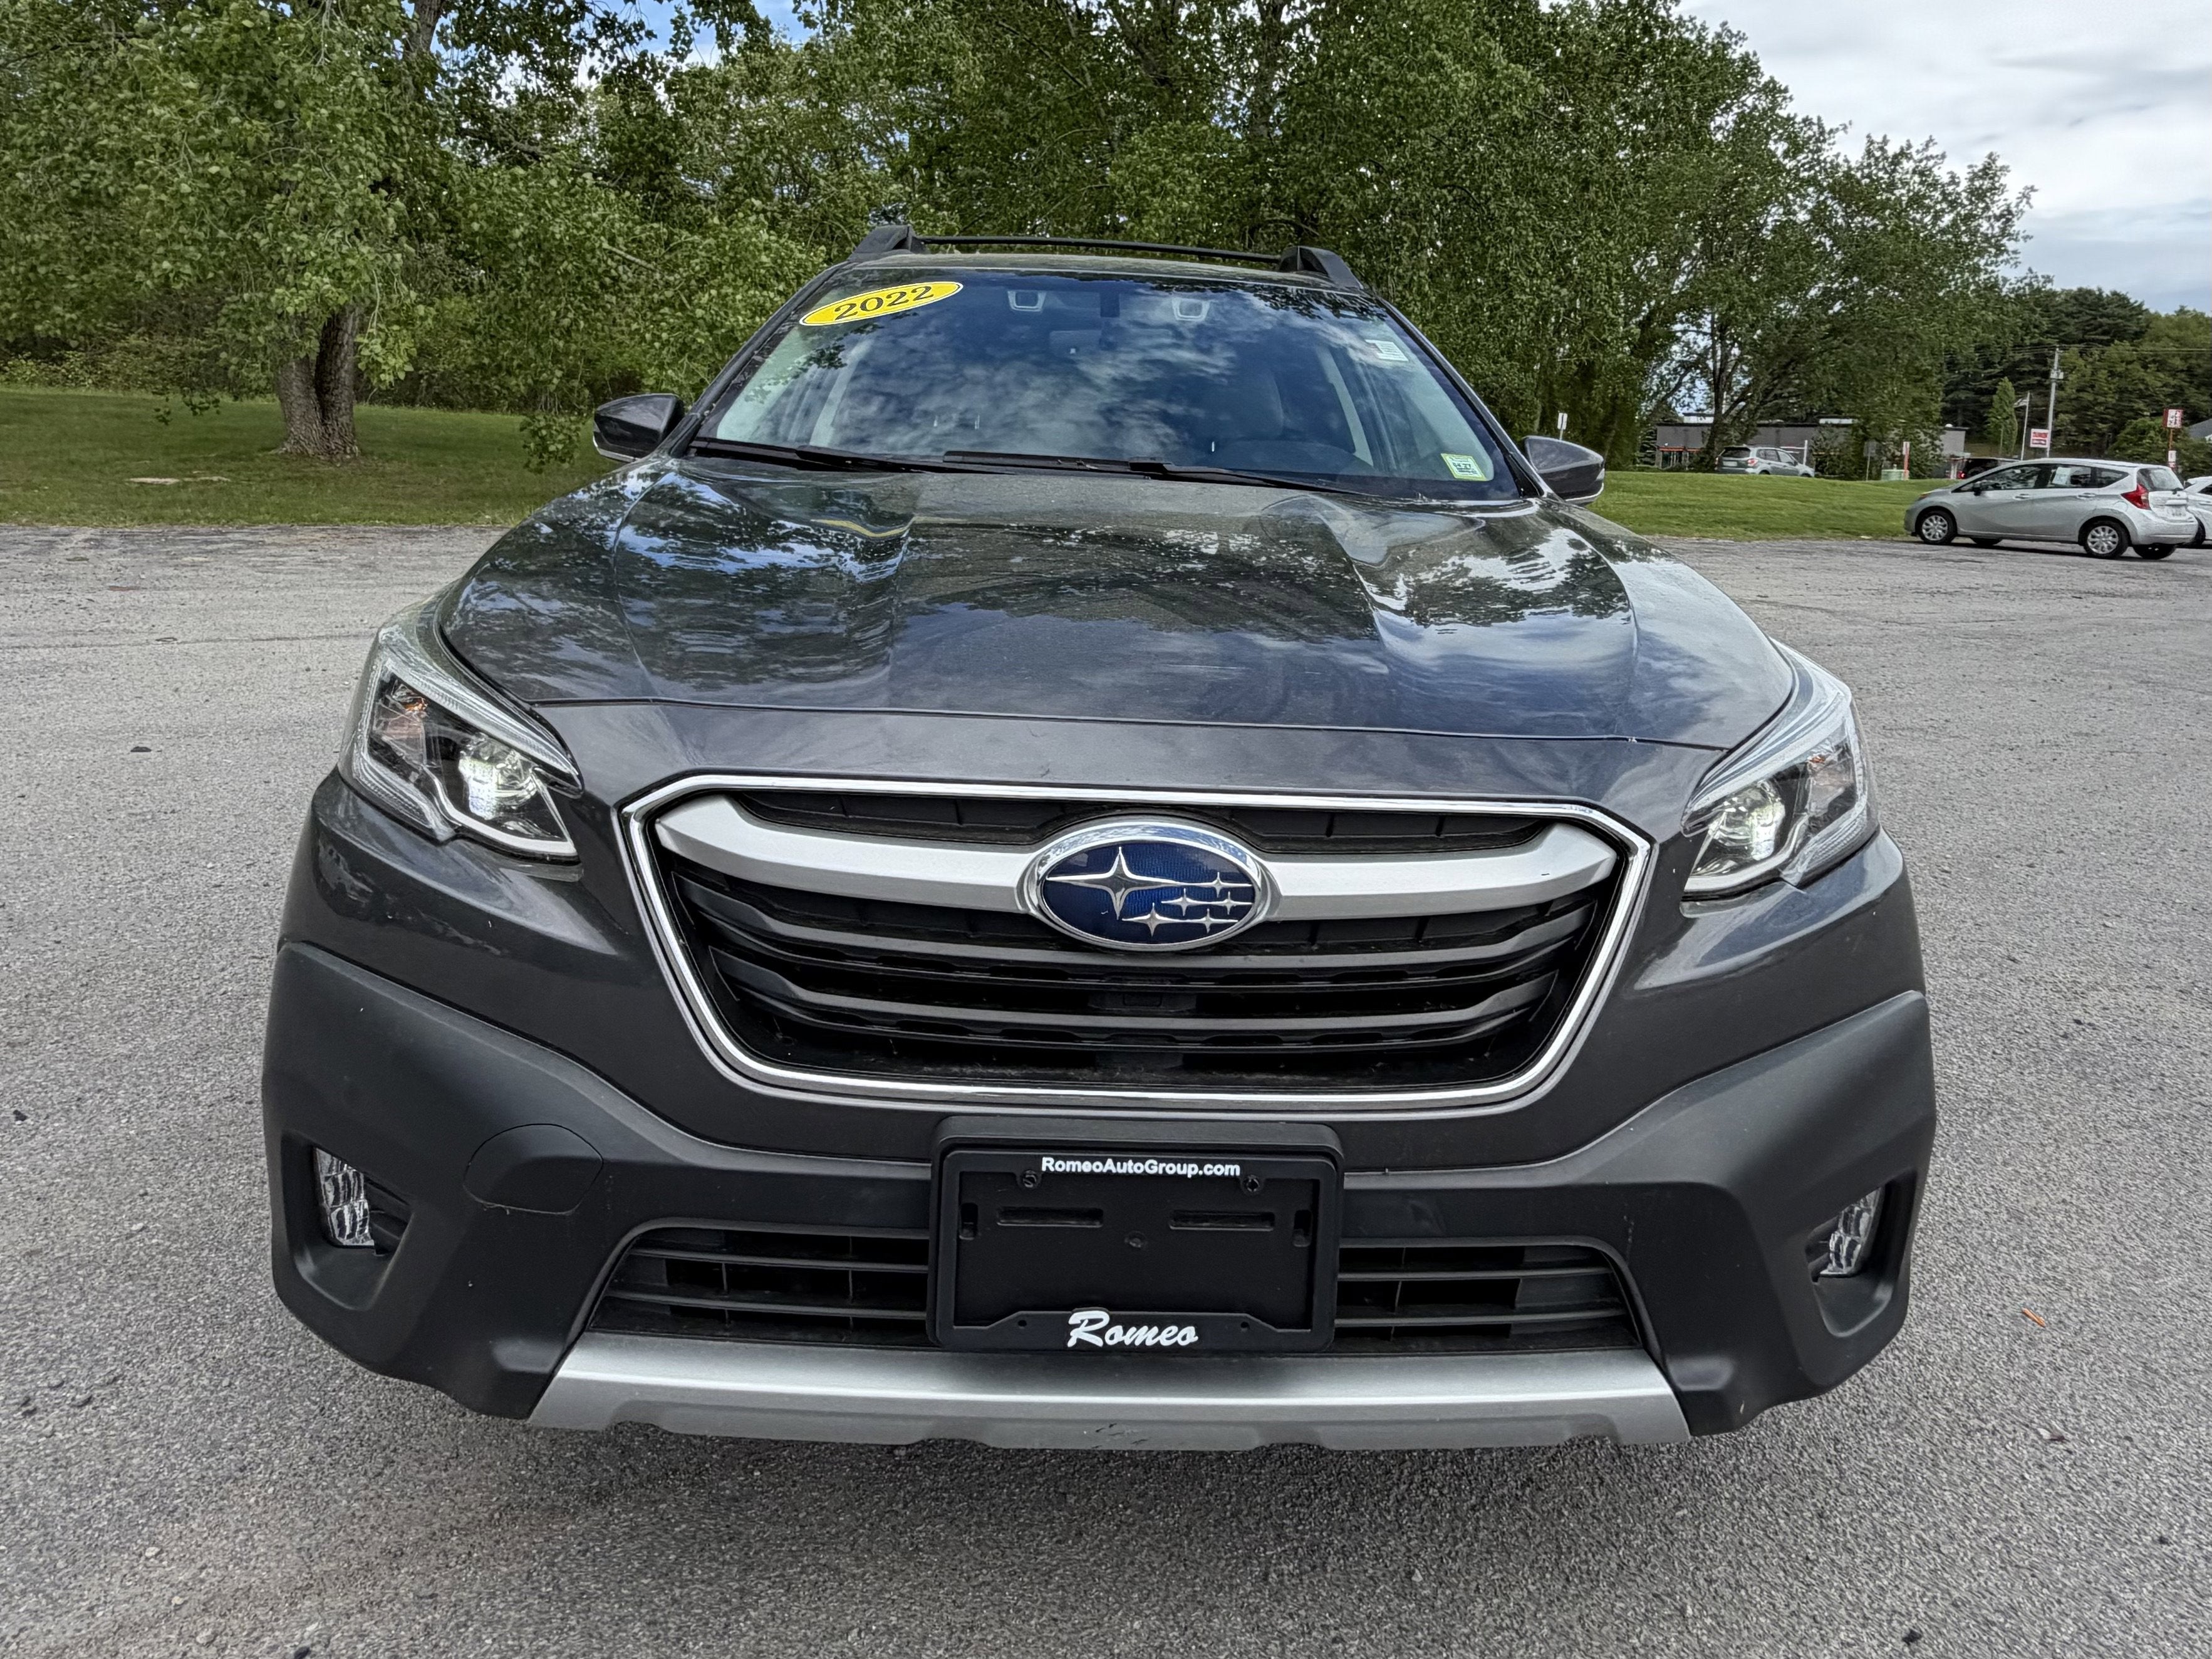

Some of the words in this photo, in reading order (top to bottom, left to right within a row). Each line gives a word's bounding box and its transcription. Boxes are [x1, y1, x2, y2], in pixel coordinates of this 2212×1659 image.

[834, 286, 934, 320] 2022
[1042, 1157, 1240, 1178] RomeoAutoGroup.com
[1067, 1310, 1198, 1347] Romeo
